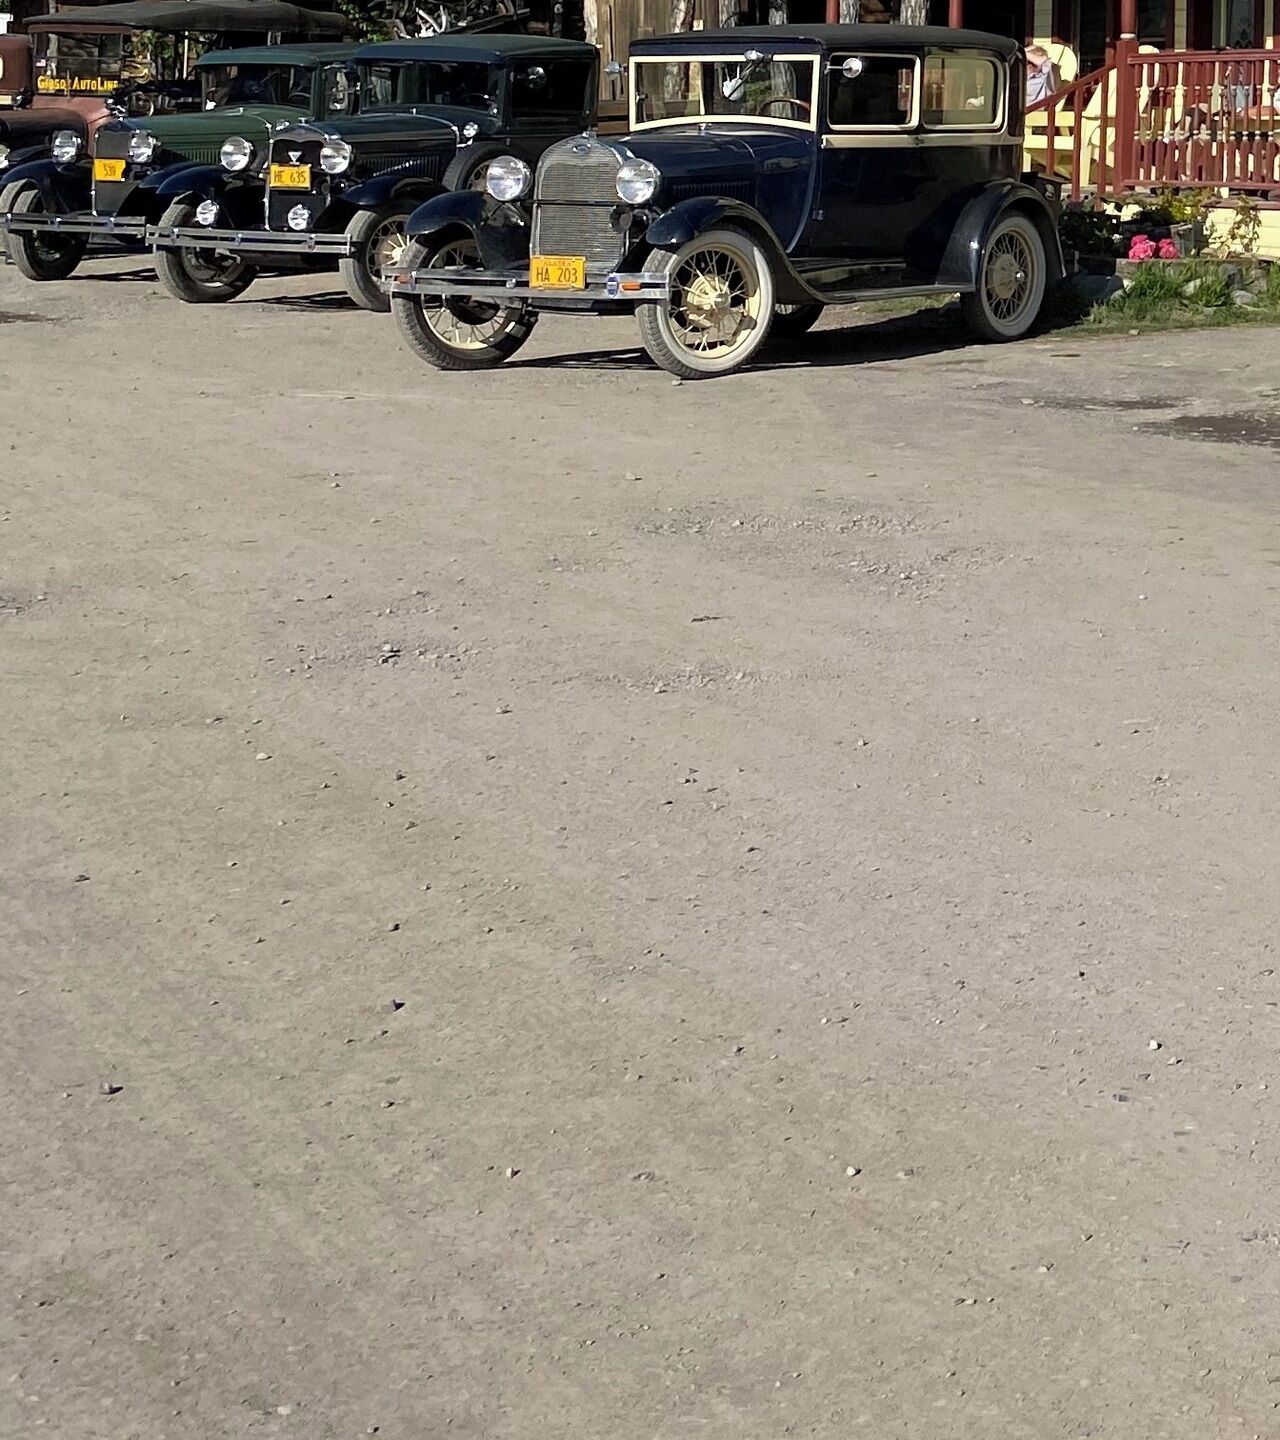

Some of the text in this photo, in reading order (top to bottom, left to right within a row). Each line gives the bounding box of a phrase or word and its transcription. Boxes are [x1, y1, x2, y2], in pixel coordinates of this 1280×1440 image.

[289, 170, 307, 184] 635
[536, 266, 578, 284] HA 203
